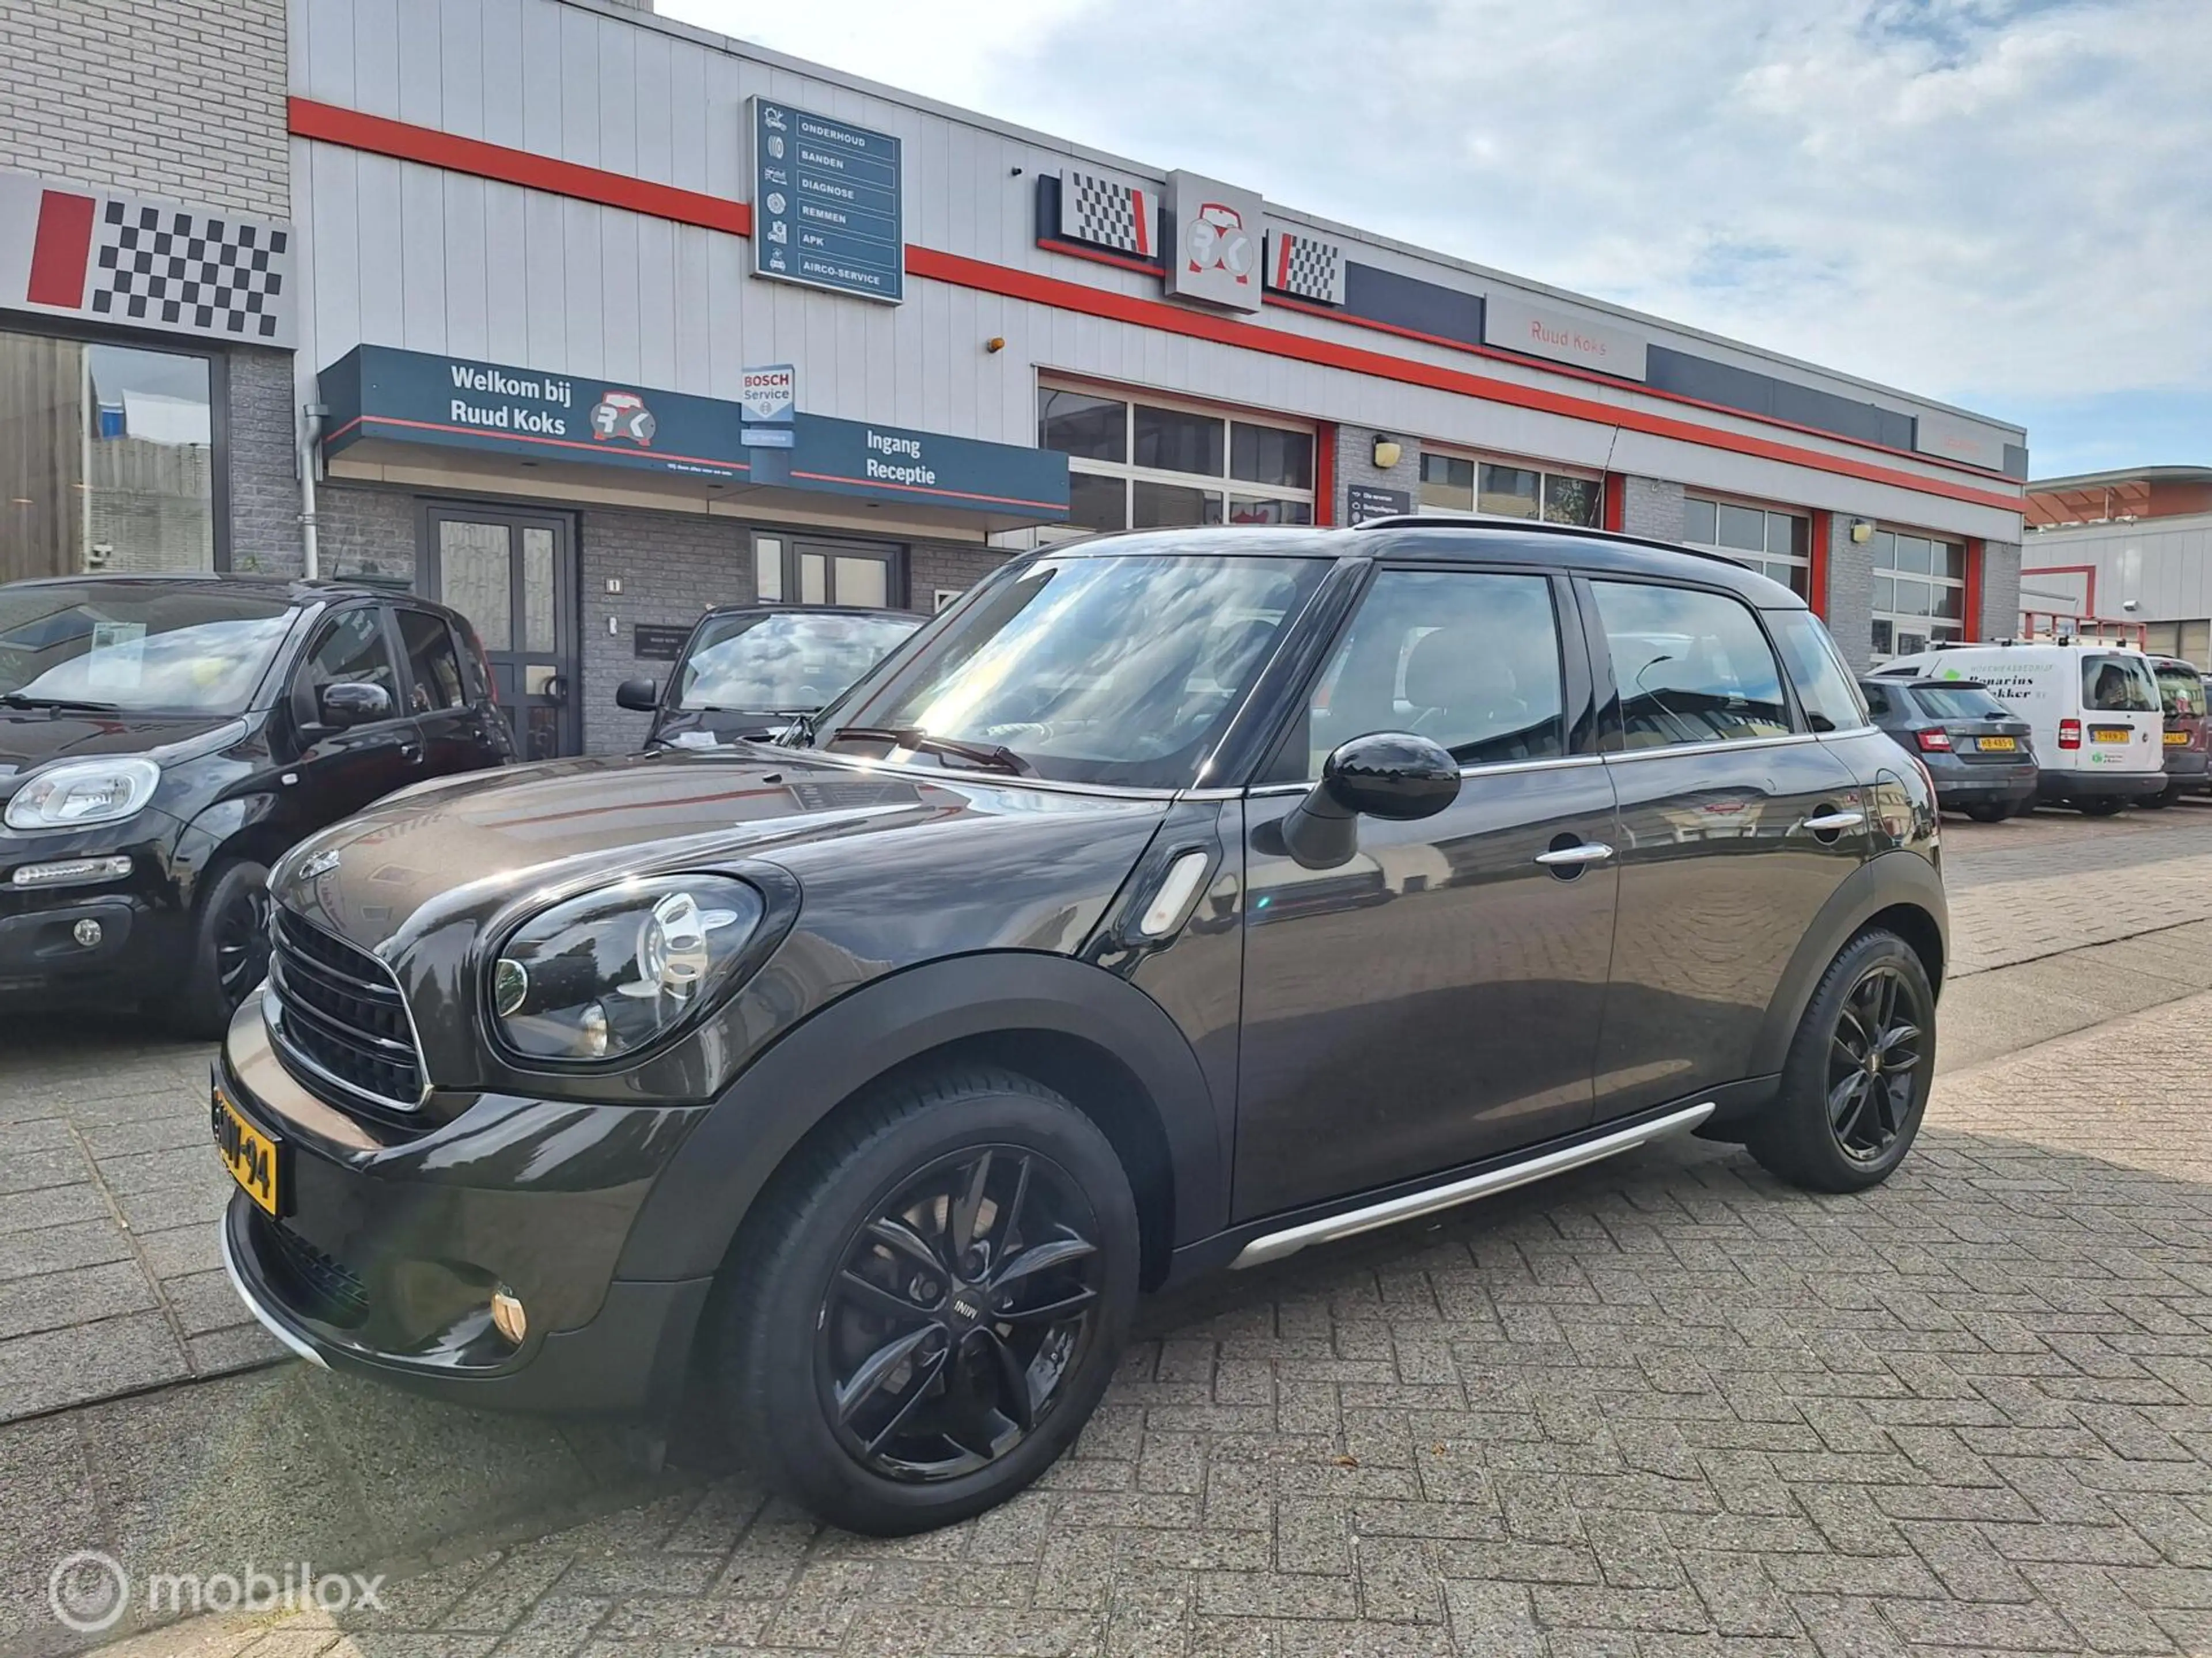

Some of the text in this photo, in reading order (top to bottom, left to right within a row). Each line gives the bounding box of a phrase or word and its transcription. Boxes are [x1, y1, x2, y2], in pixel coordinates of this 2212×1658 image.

[802, 122, 866, 147] ONDERHOUD
[802, 151, 844, 169] BANDEN
[802, 180, 854, 199] DIAGNOSE
[802, 206, 846, 224] REMMEN
[802, 234, 824, 247] APK
[803, 261, 880, 285] AIRCO-SERVICE
[1531, 320, 1607, 355] Ruud Koks
[450, 365, 572, 408] Welkom bij
[744, 373, 789, 387] BOSCH
[744, 389, 790, 400] Service
[450, 399, 566, 436] Ruud Koks
[866, 430, 921, 460] Ingang
[866, 458, 936, 486] Receptie
[953, 1299, 979, 1321] MINI
